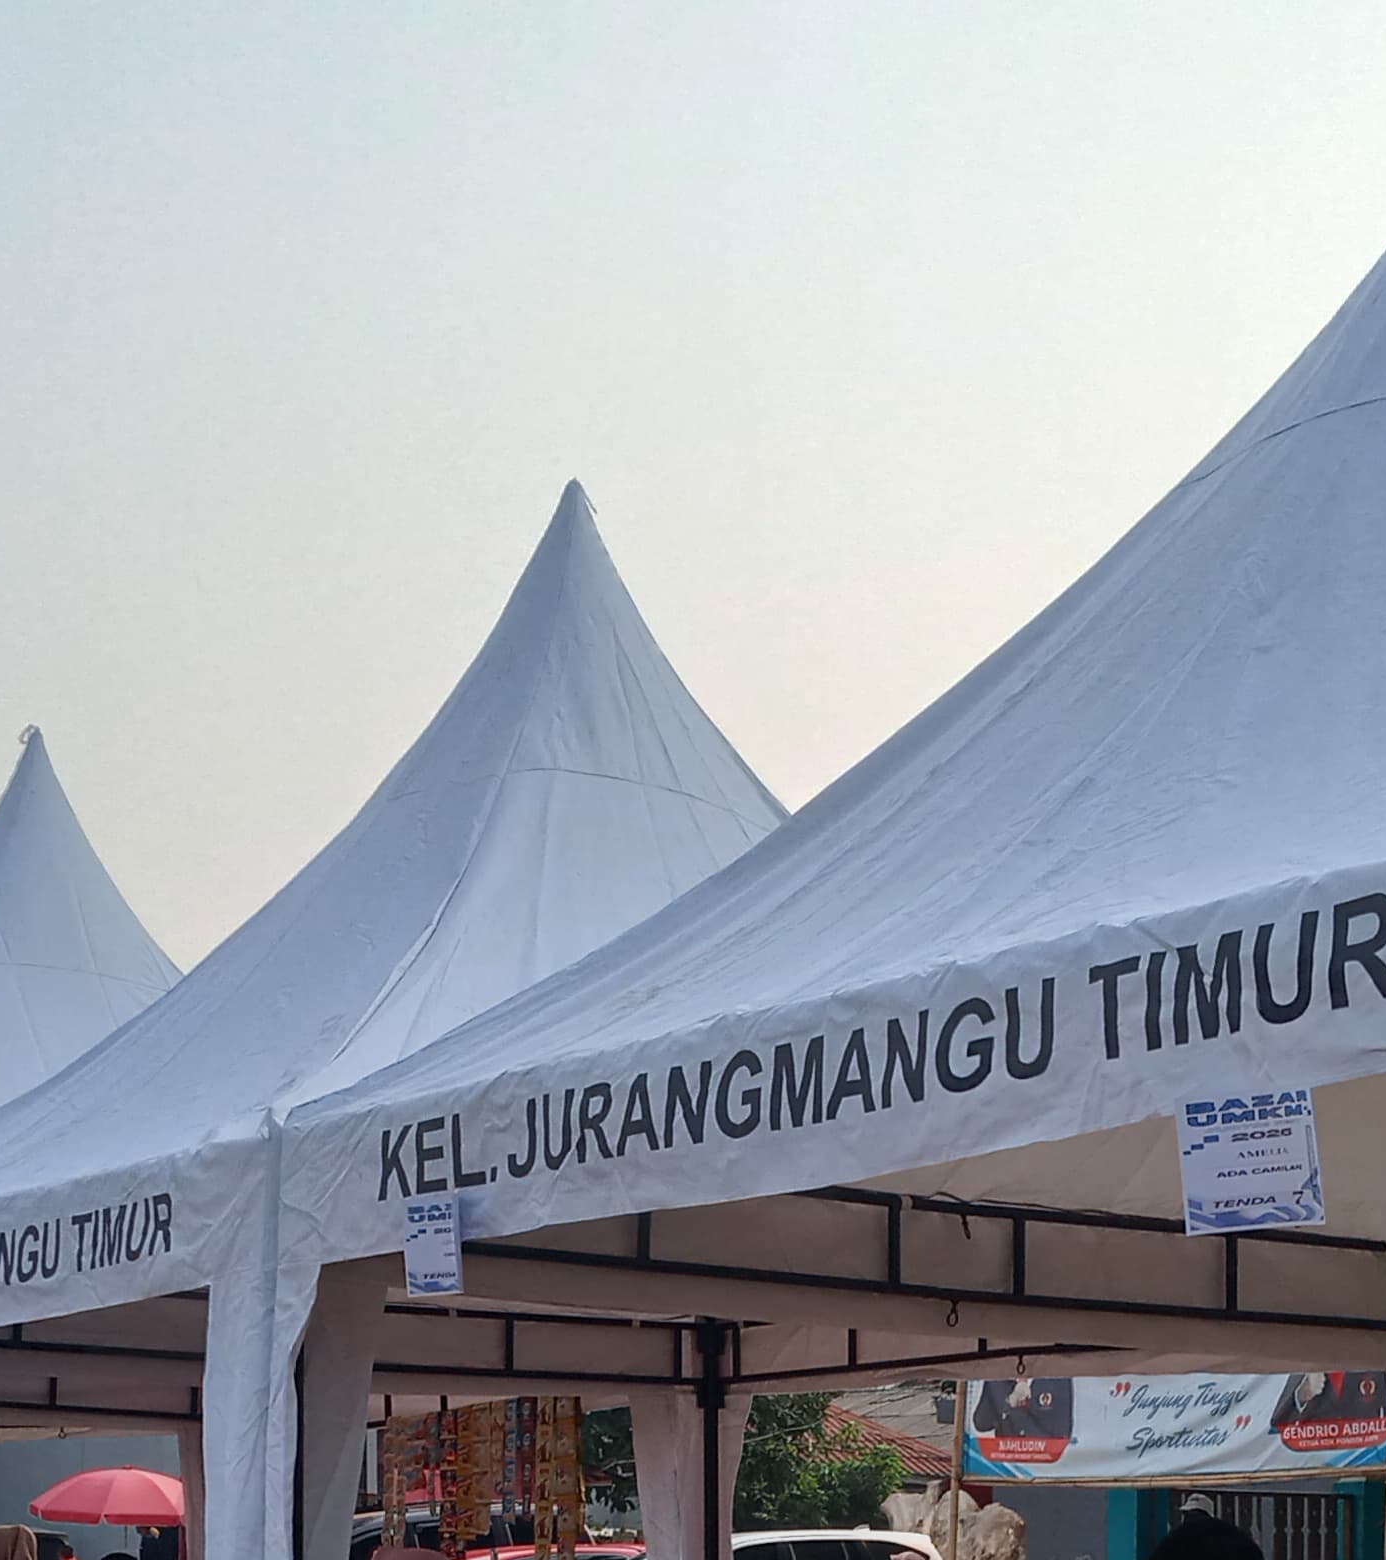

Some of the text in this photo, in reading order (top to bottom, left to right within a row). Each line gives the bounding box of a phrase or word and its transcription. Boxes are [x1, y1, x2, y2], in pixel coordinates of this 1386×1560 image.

[1185, 1090, 1308, 1115] BAZAR
[1217, 1164, 1303, 1178] ADA CAMILAN
[1213, 1191, 1304, 1209] TENDA 7
[71, 1193, 173, 1273] TIMUR
[1122, 1383, 1194, 1420] Junjung
